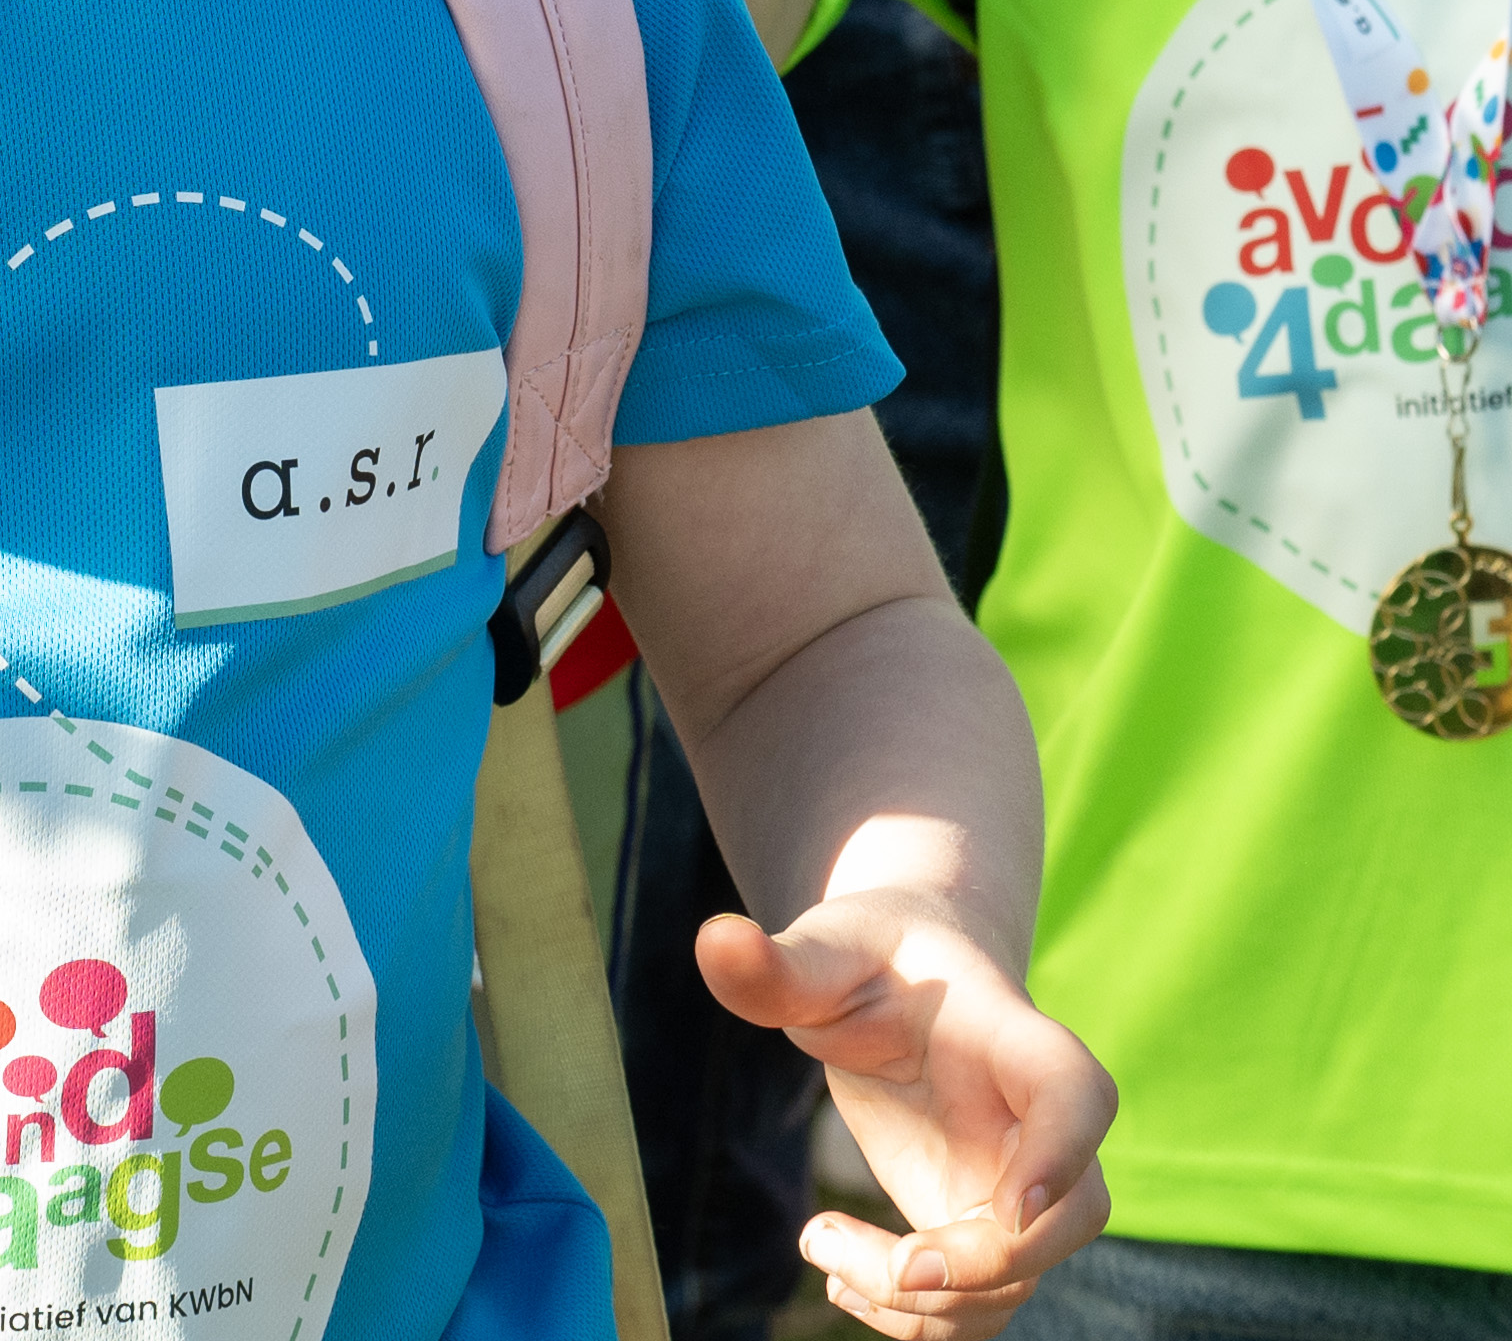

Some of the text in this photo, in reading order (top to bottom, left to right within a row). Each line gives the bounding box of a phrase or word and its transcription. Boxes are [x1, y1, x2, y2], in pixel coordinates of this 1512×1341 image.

[240, 428, 439, 521] a.s.r.
[94, 1298, 159, 1325] van
[168, 1277, 255, 1320] KWbN
